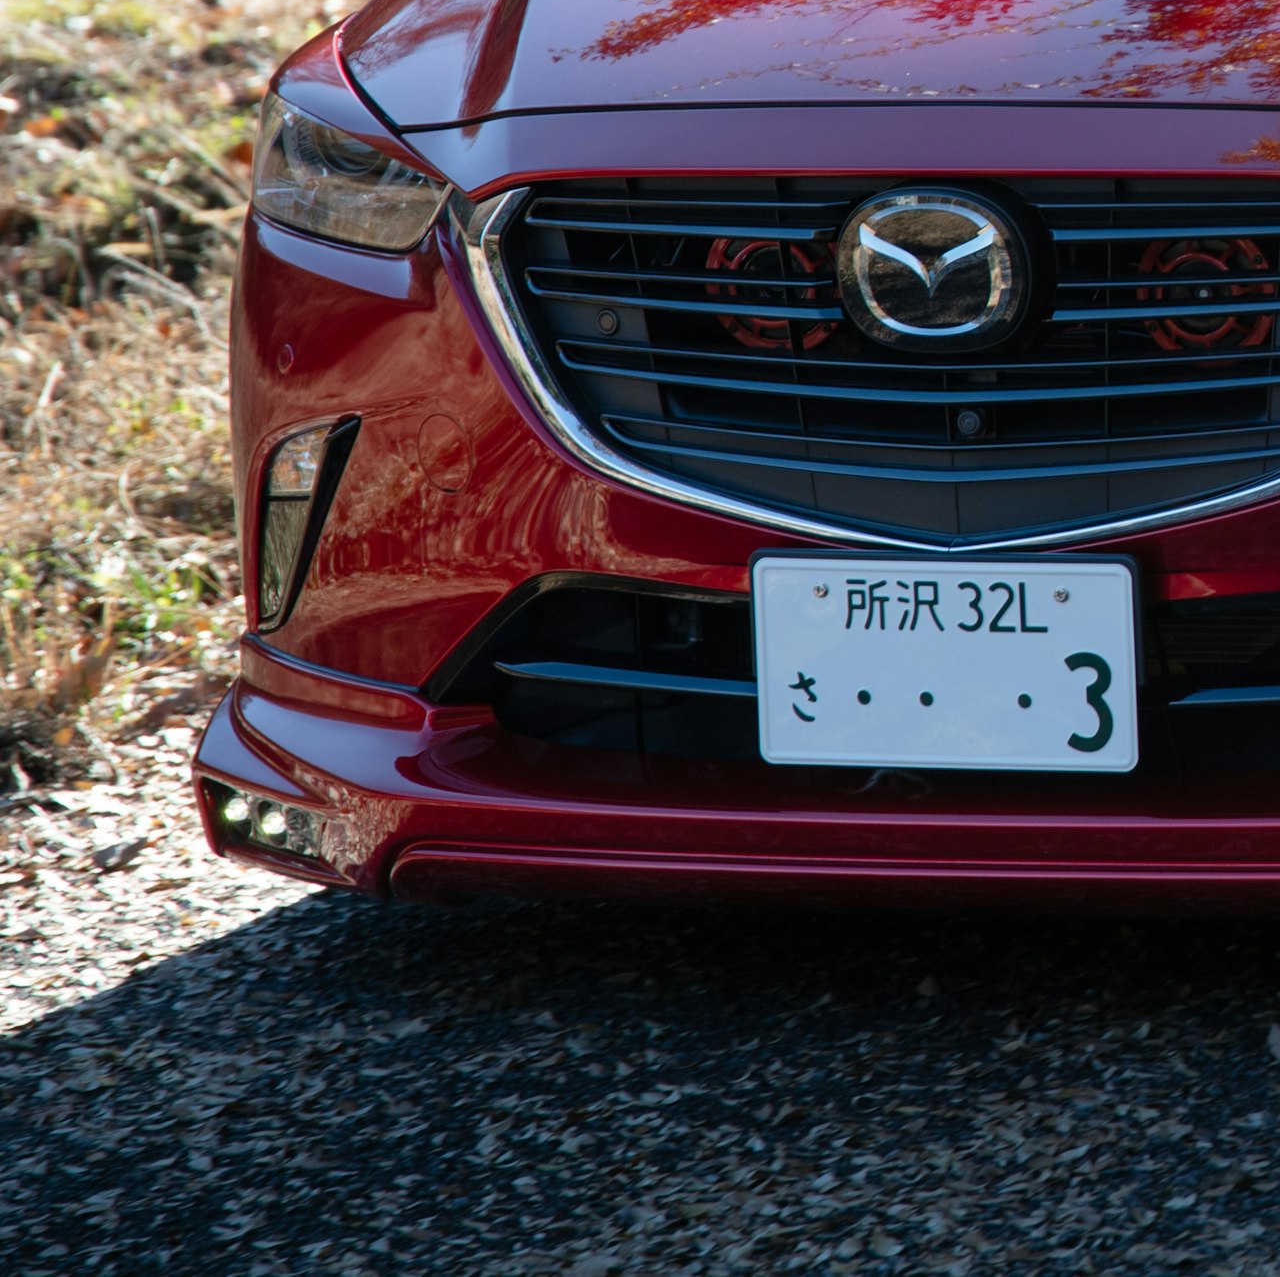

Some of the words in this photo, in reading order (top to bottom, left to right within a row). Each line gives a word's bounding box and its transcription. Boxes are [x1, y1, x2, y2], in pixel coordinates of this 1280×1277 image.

[845, 579, 945, 631] 所沢
[957, 581, 1049, 633] 32L
[788, 671, 818, 722] さ
